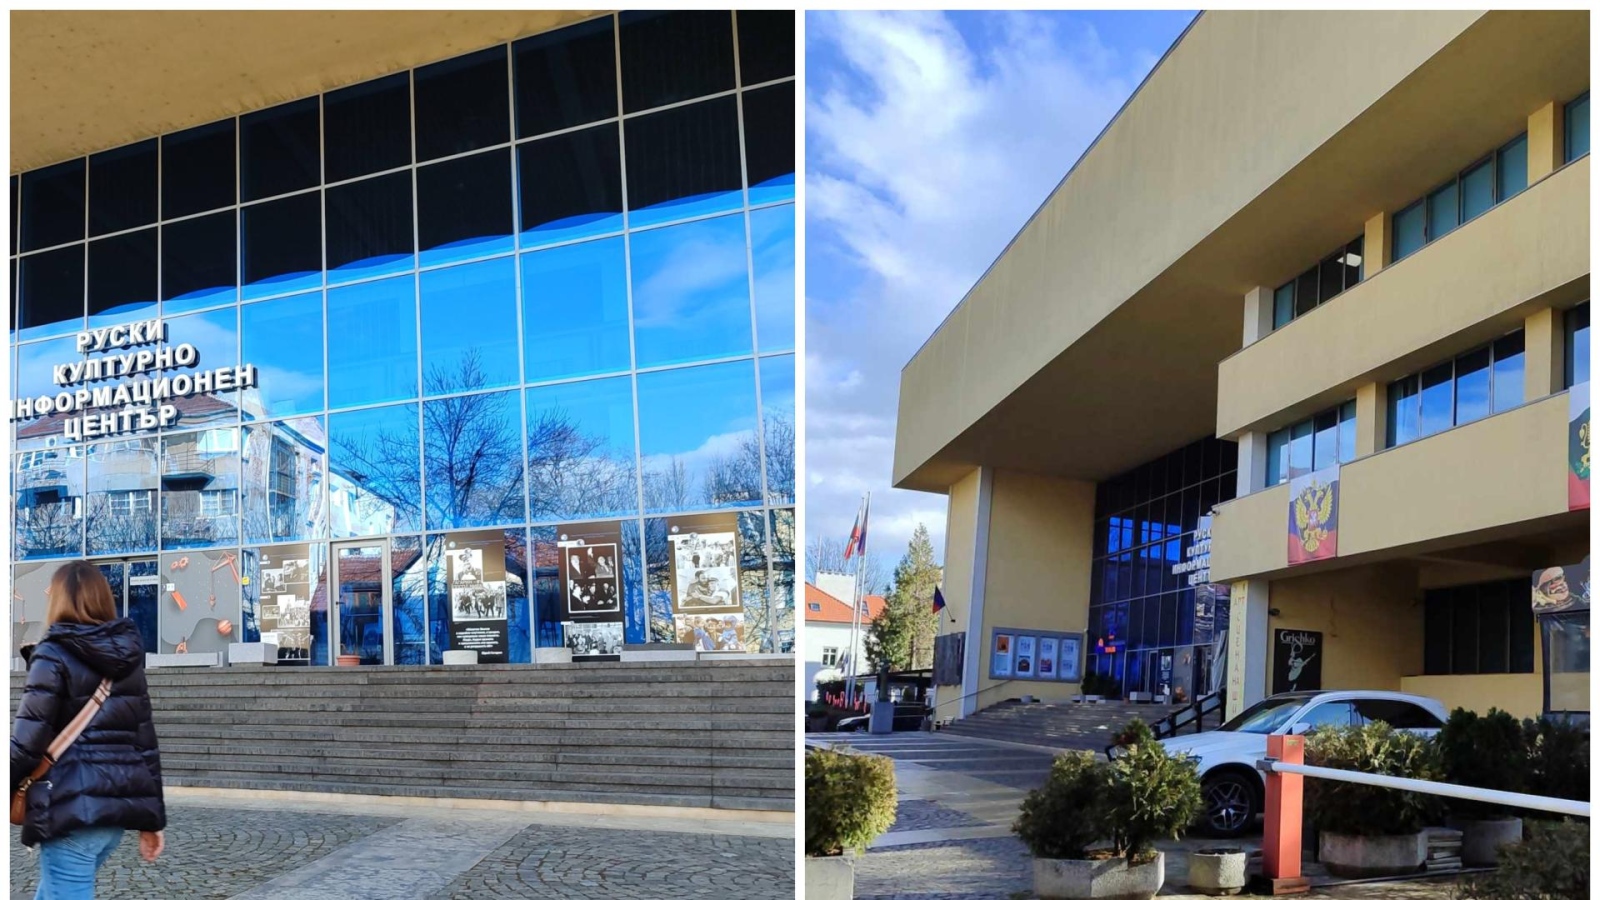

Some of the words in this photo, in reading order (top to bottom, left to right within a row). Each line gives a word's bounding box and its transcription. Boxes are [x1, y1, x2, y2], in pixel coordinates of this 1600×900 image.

[76, 319, 168, 353] РУСКИ
[53, 343, 199, 387] КУЛТУРНО
[63, 405, 181, 441] ЦЕНТЪР
[1280, 630, 1317, 647] Grishko
